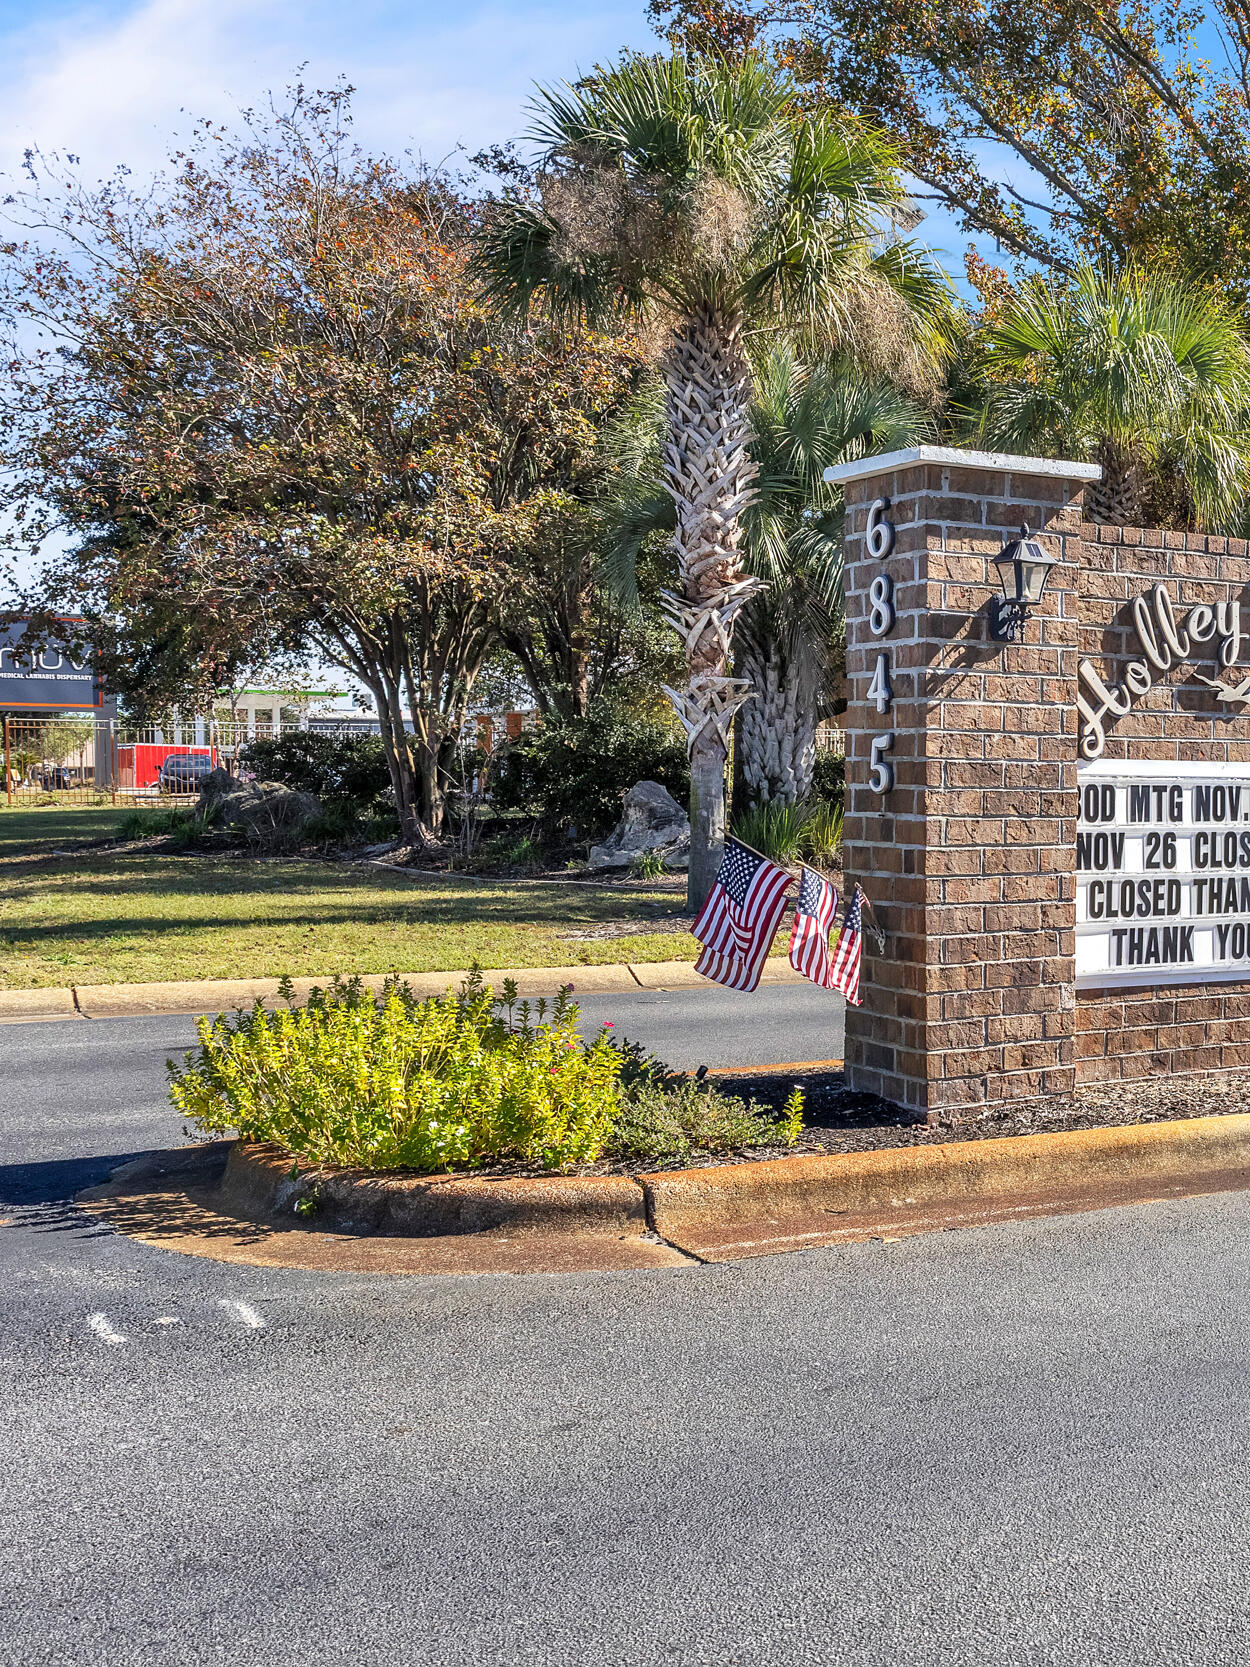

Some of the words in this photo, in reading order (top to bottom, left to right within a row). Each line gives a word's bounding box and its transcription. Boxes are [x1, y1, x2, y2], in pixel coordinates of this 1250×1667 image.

[866, 497, 895, 795] 6845
[1077, 582, 1250, 760] Holley
[1131, 785, 1183, 822] MTG
[1196, 785, 1249, 822] NOV.
[1077, 832, 1125, 870] NOV
[1146, 832, 1177, 870] 26
[1089, 878, 1181, 919] CLOSED
[1112, 925, 1194, 966] THANK
